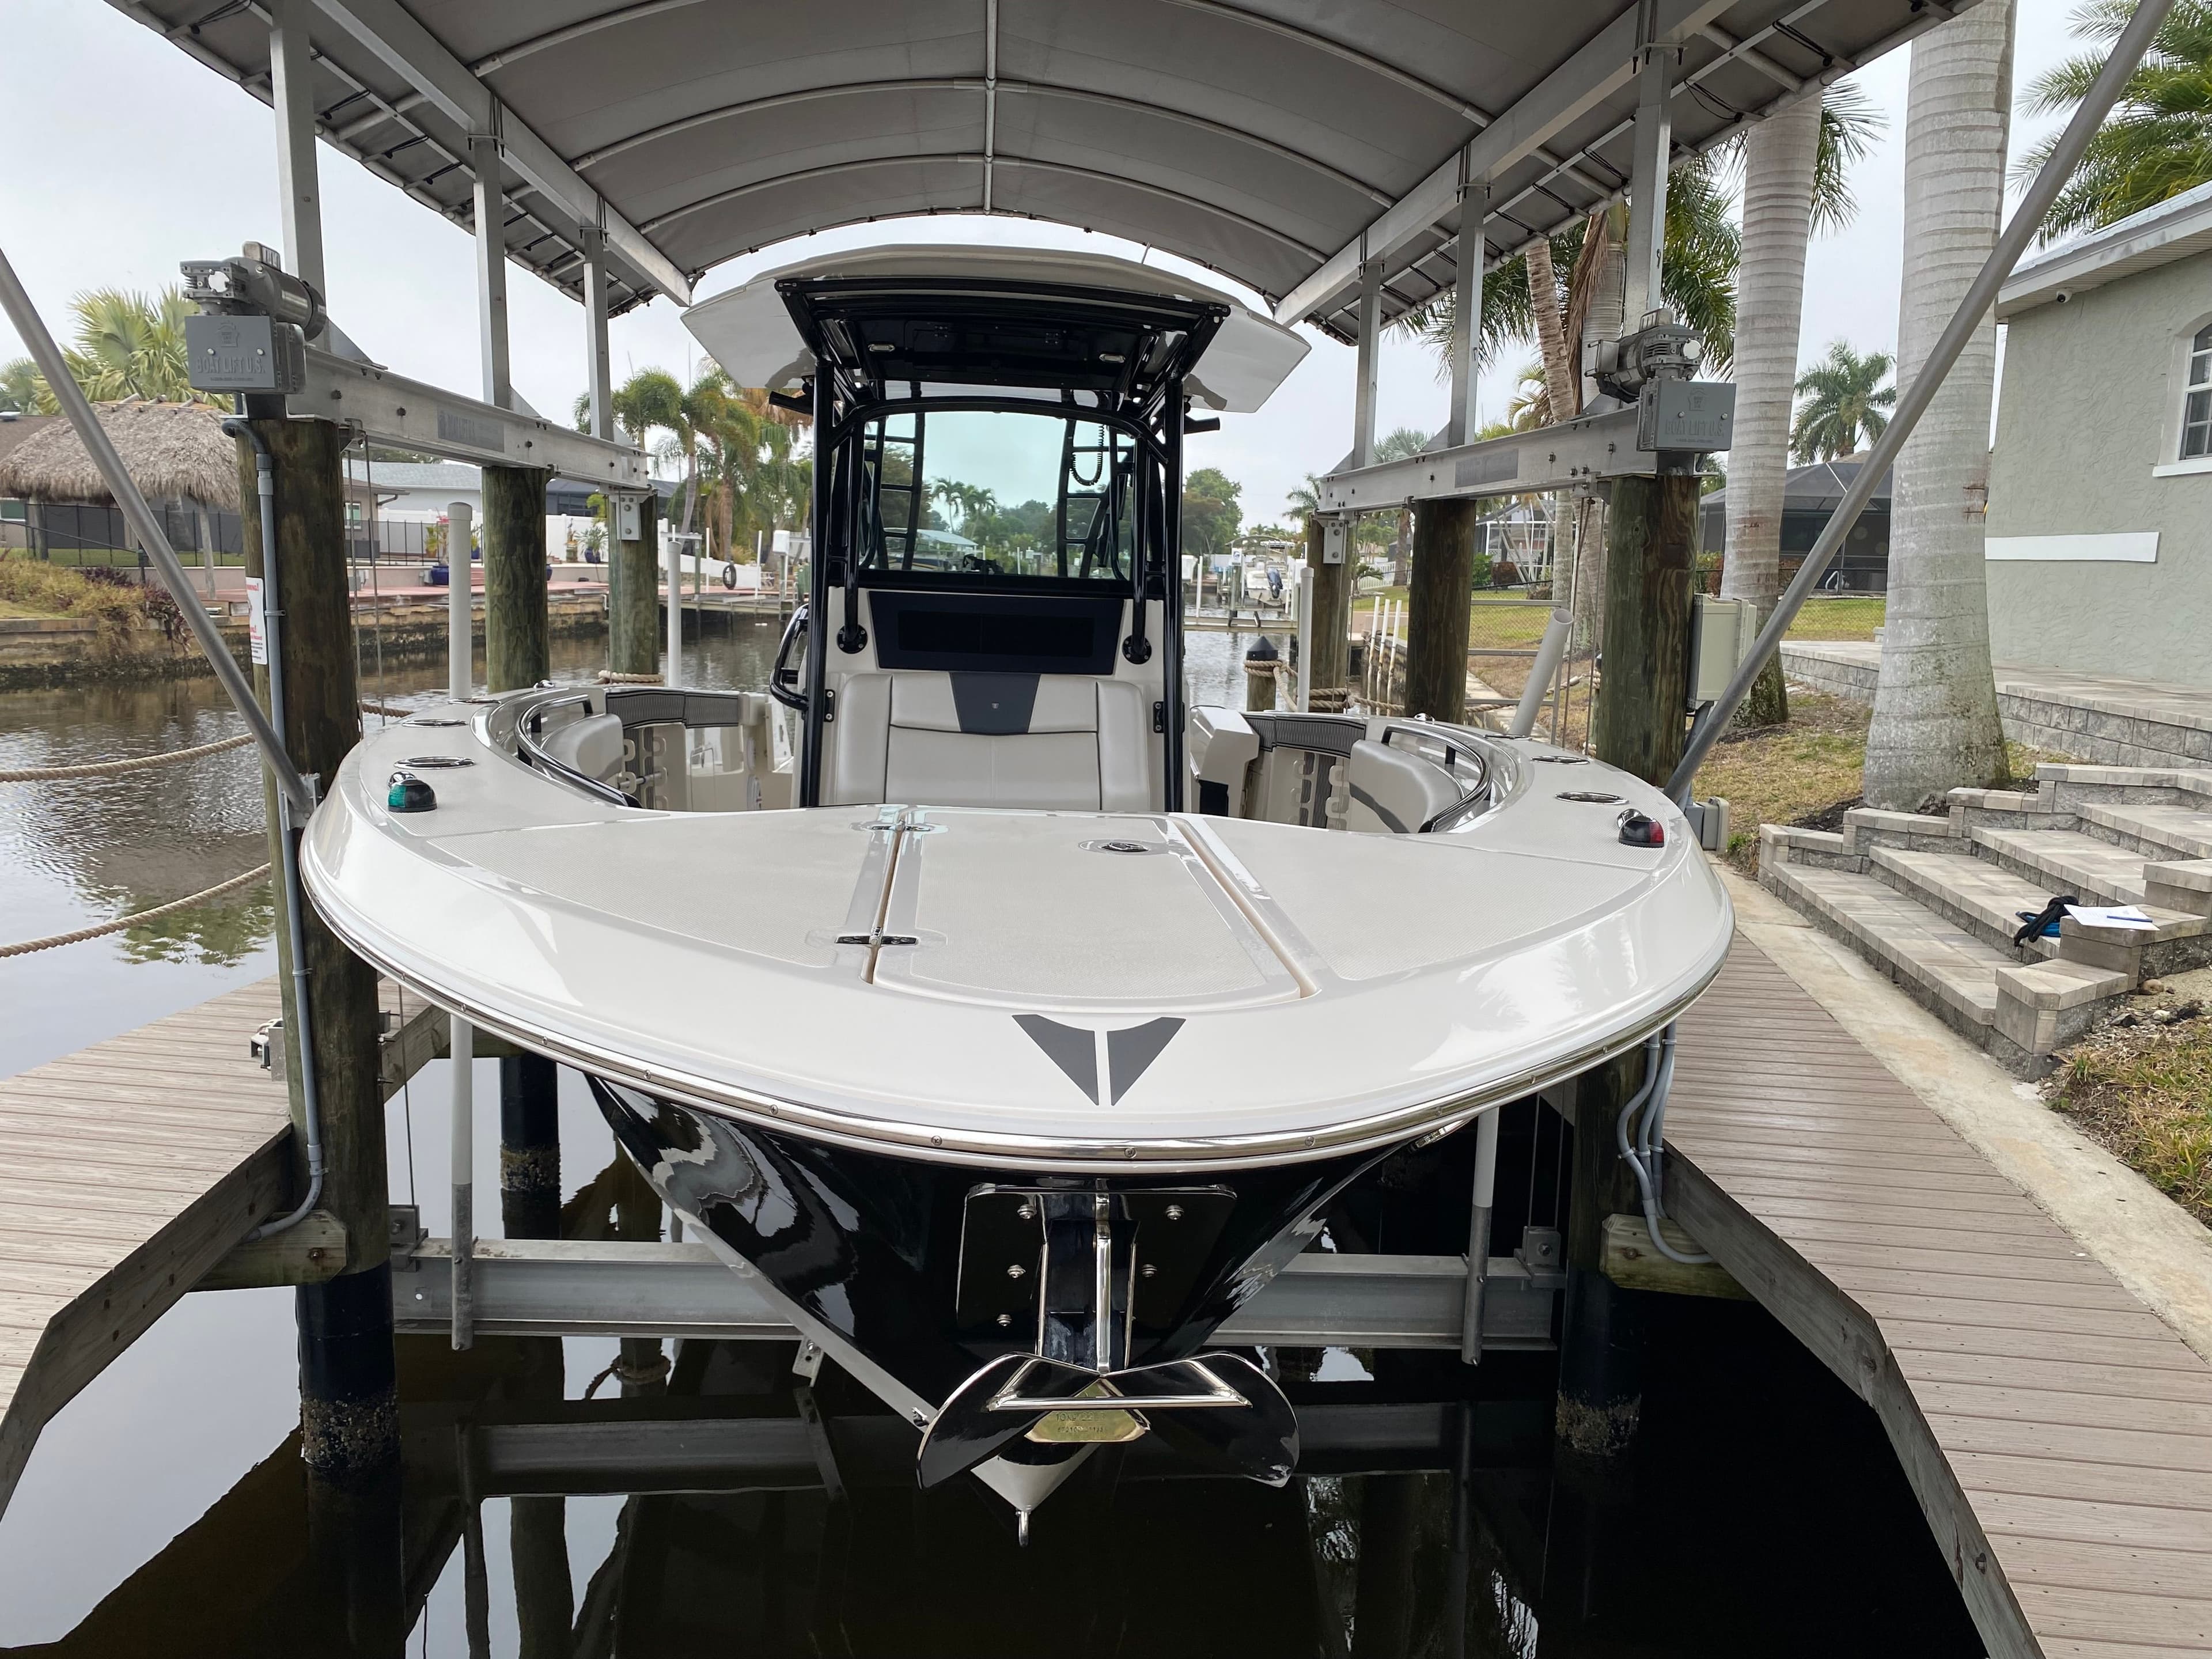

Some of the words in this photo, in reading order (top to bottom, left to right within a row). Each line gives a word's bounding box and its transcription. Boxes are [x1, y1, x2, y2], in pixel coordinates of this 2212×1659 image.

[196, 355, 220, 373] BOAT
[223, 356, 244, 373] LIFT
[246, 356, 266, 373] U.S.
[1665, 419, 1685, 435] BOAT
[1688, 419, 1707, 436] LIFT
[1709, 419, 1724, 437] U.S.
